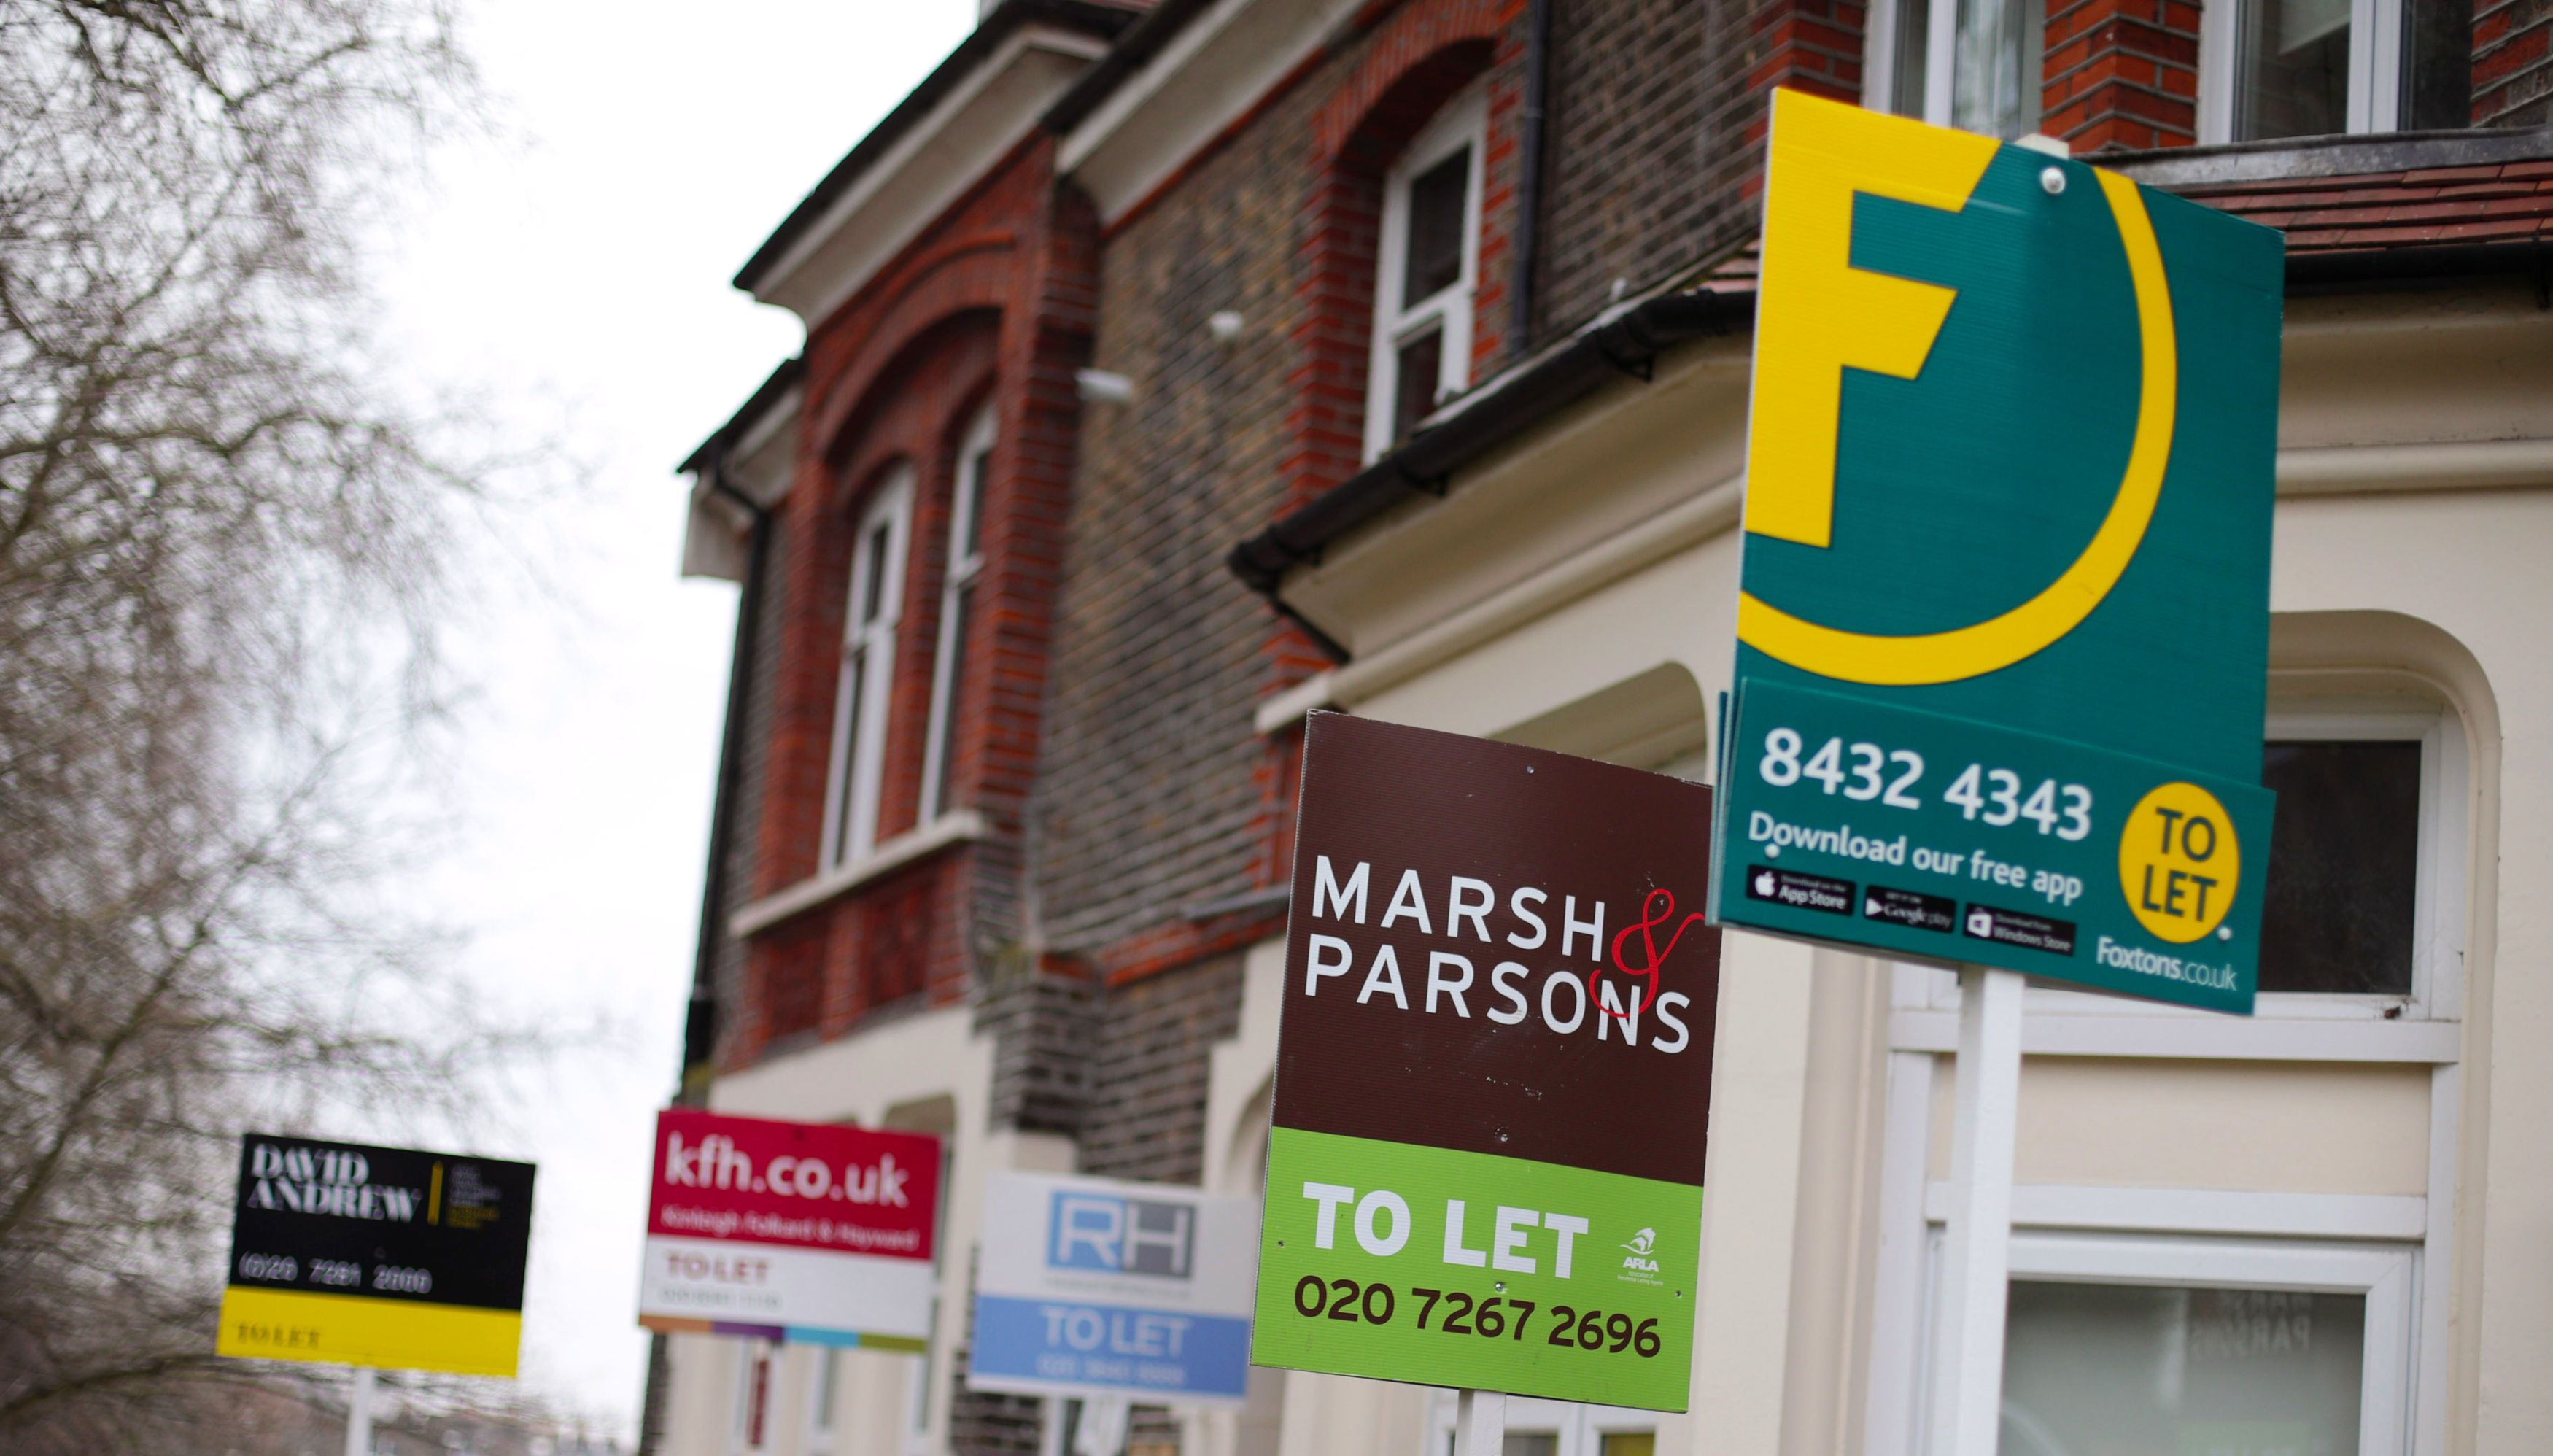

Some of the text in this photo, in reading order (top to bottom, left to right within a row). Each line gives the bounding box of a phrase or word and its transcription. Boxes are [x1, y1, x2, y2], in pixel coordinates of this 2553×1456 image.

[1759, 727, 2092, 841] 8432 4343
[1748, 810, 2082, 907] Download our free app
[2155, 807, 2216, 862] TO
[1312, 855, 1605, 963] MARSH
[1778, 884, 1847, 910] App Store
[1883, 902, 1925, 925] Google
[2142, 864, 2218, 922] LET
[1994, 926, 2071, 952] Windows Store
[2096, 935, 2238, 991] Foxtons.co.uk
[1305, 933, 1691, 1055] PARSONS
[251, 1142, 369, 1187] DAVID
[665, 1130, 910, 1208] kfh.co.uk
[246, 1177, 422, 1223] ANDREW
[1057, 1198, 1190, 1275] RH
[1302, 1182, 1589, 1279] TO LET
[666, 1252, 769, 1285] TO LET
[1622, 1256, 1659, 1272] ARLA
[1038, 1304, 1193, 1357] TO LET
[1295, 1275, 1661, 1358] 020 7267 2696
